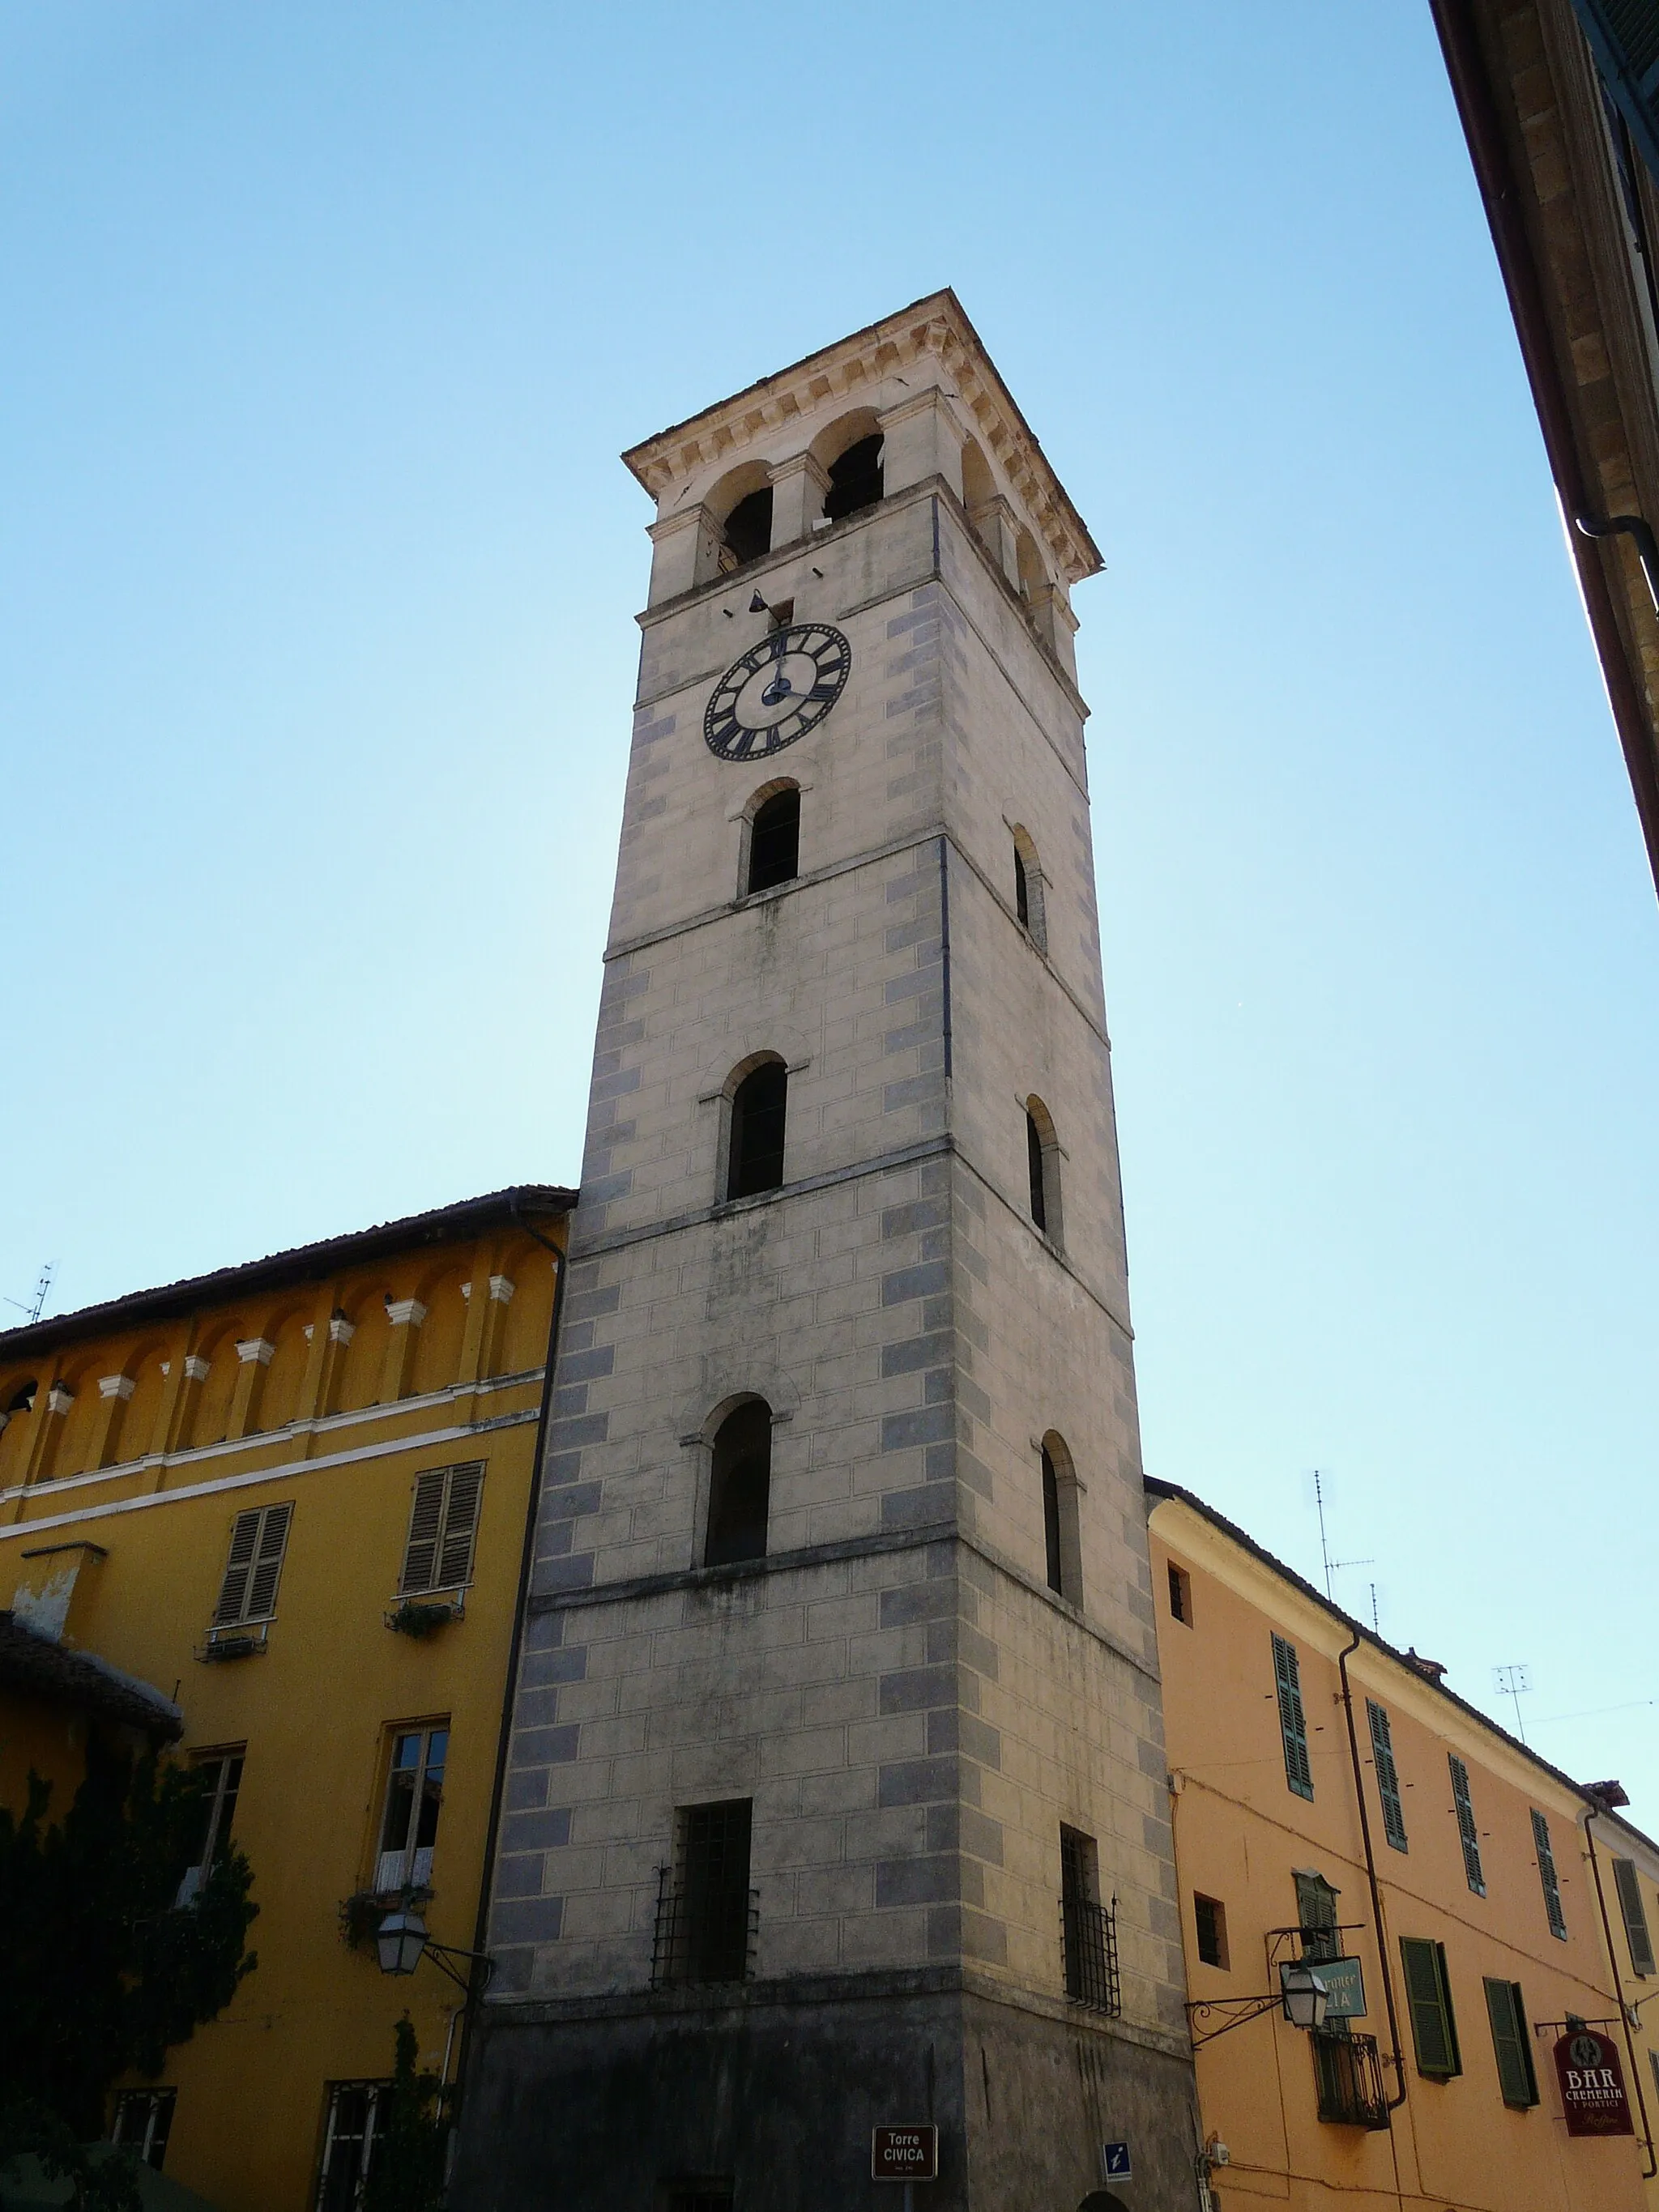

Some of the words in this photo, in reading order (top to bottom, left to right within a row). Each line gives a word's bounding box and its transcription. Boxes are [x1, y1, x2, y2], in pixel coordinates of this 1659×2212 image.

[1566, 2069, 1617, 2090] BAR
[1566, 2088, 1623, 2101] CREMERIA
[1582, 2099, 1618, 2109] PORTICI
[888, 2133, 920, 2146] Torre
[884, 2148, 924, 2162] CIVICA
